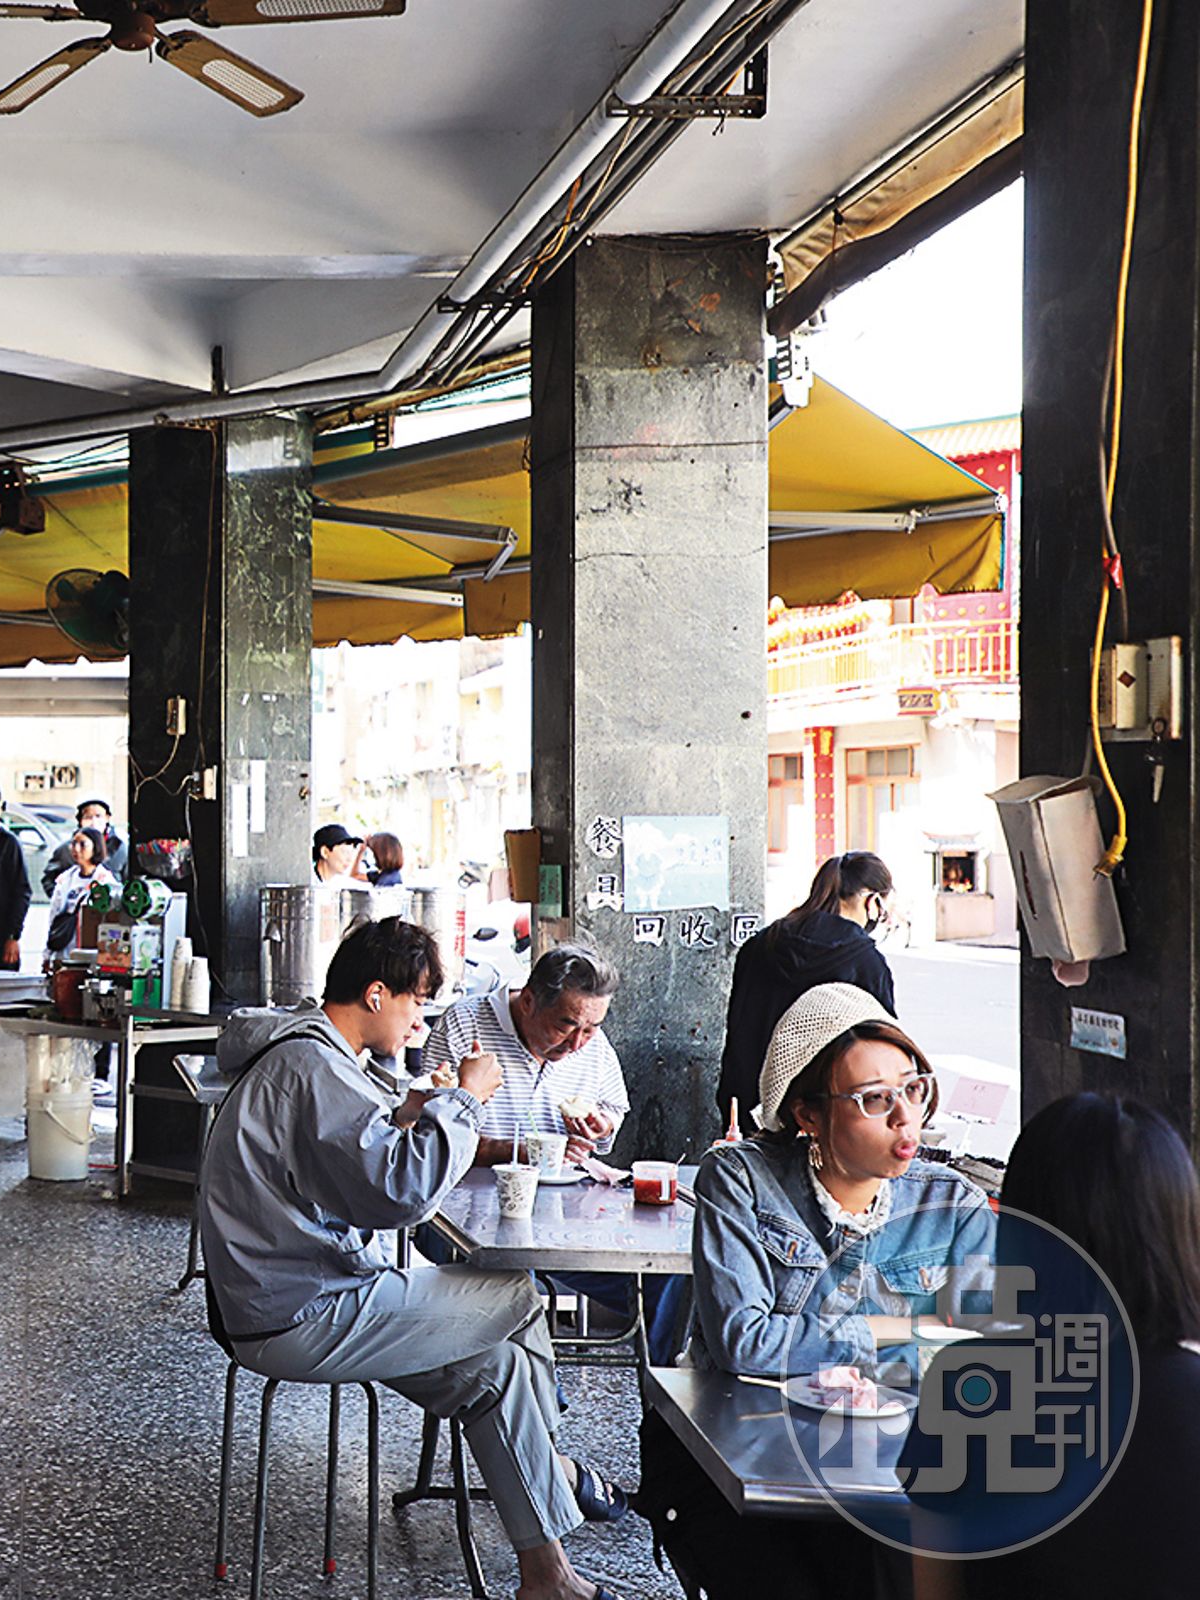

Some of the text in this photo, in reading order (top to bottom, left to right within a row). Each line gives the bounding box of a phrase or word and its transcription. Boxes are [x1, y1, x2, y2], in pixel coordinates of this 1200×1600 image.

[587, 817, 624, 911] 餐具
[634, 913, 761, 947] 回收區
